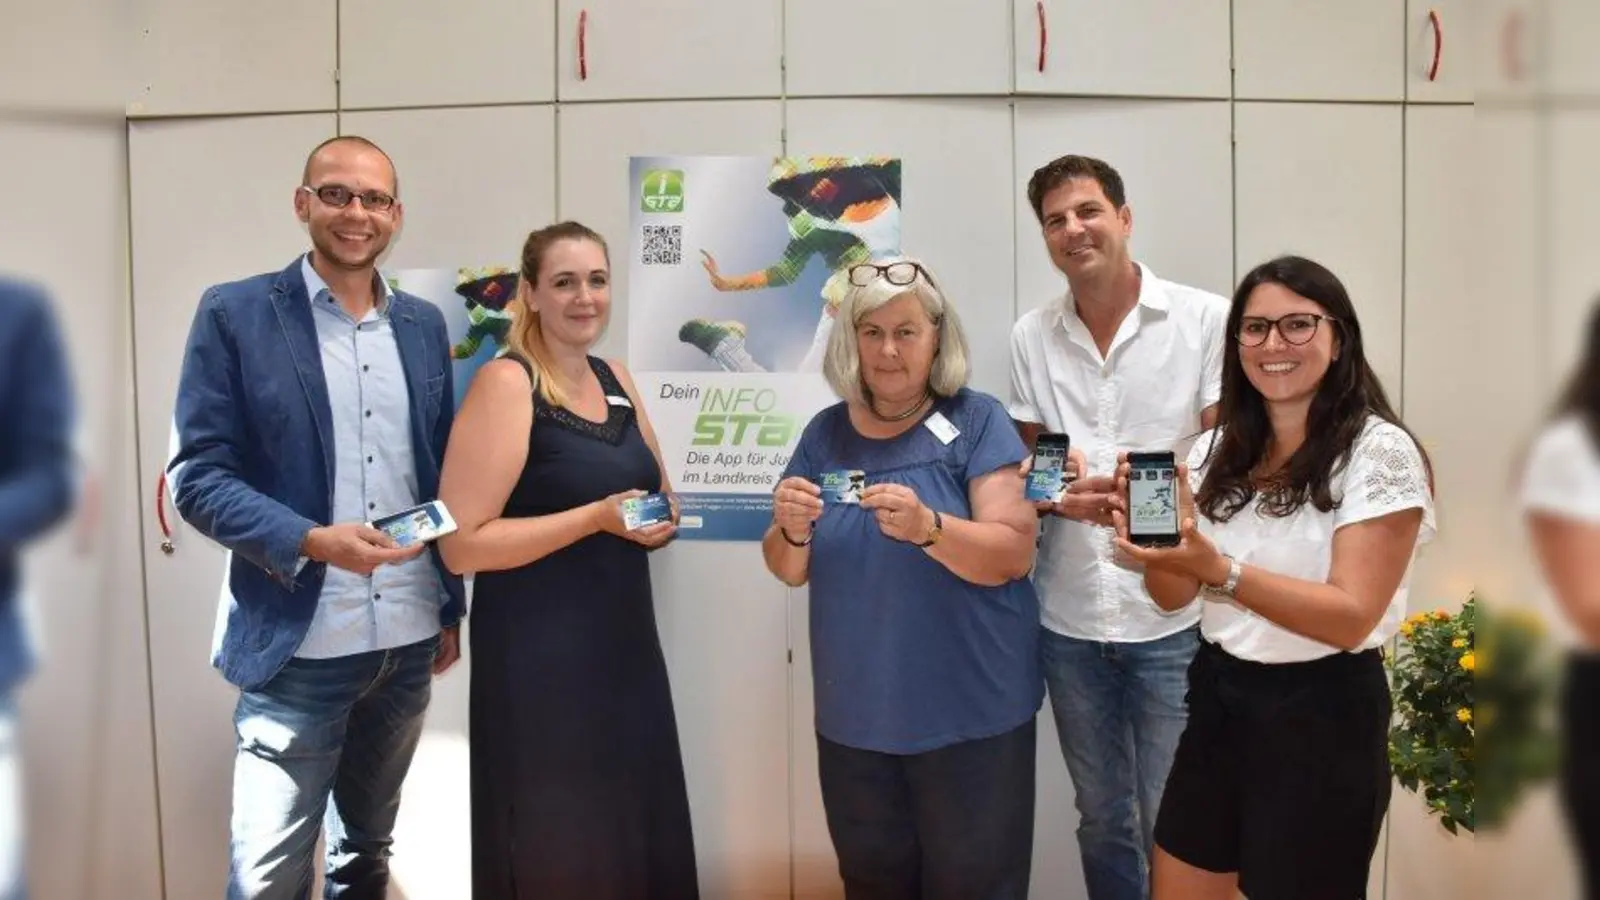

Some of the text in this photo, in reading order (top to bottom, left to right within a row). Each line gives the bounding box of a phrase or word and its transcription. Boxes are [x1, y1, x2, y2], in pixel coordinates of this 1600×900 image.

[660, 383, 777, 413] Dein INFO
[686, 451, 710, 465] Die
[714, 452, 742, 468] App
[747, 450, 767, 466] für
[682, 470, 700, 483] im
[703, 471, 774, 485] Landkreis
